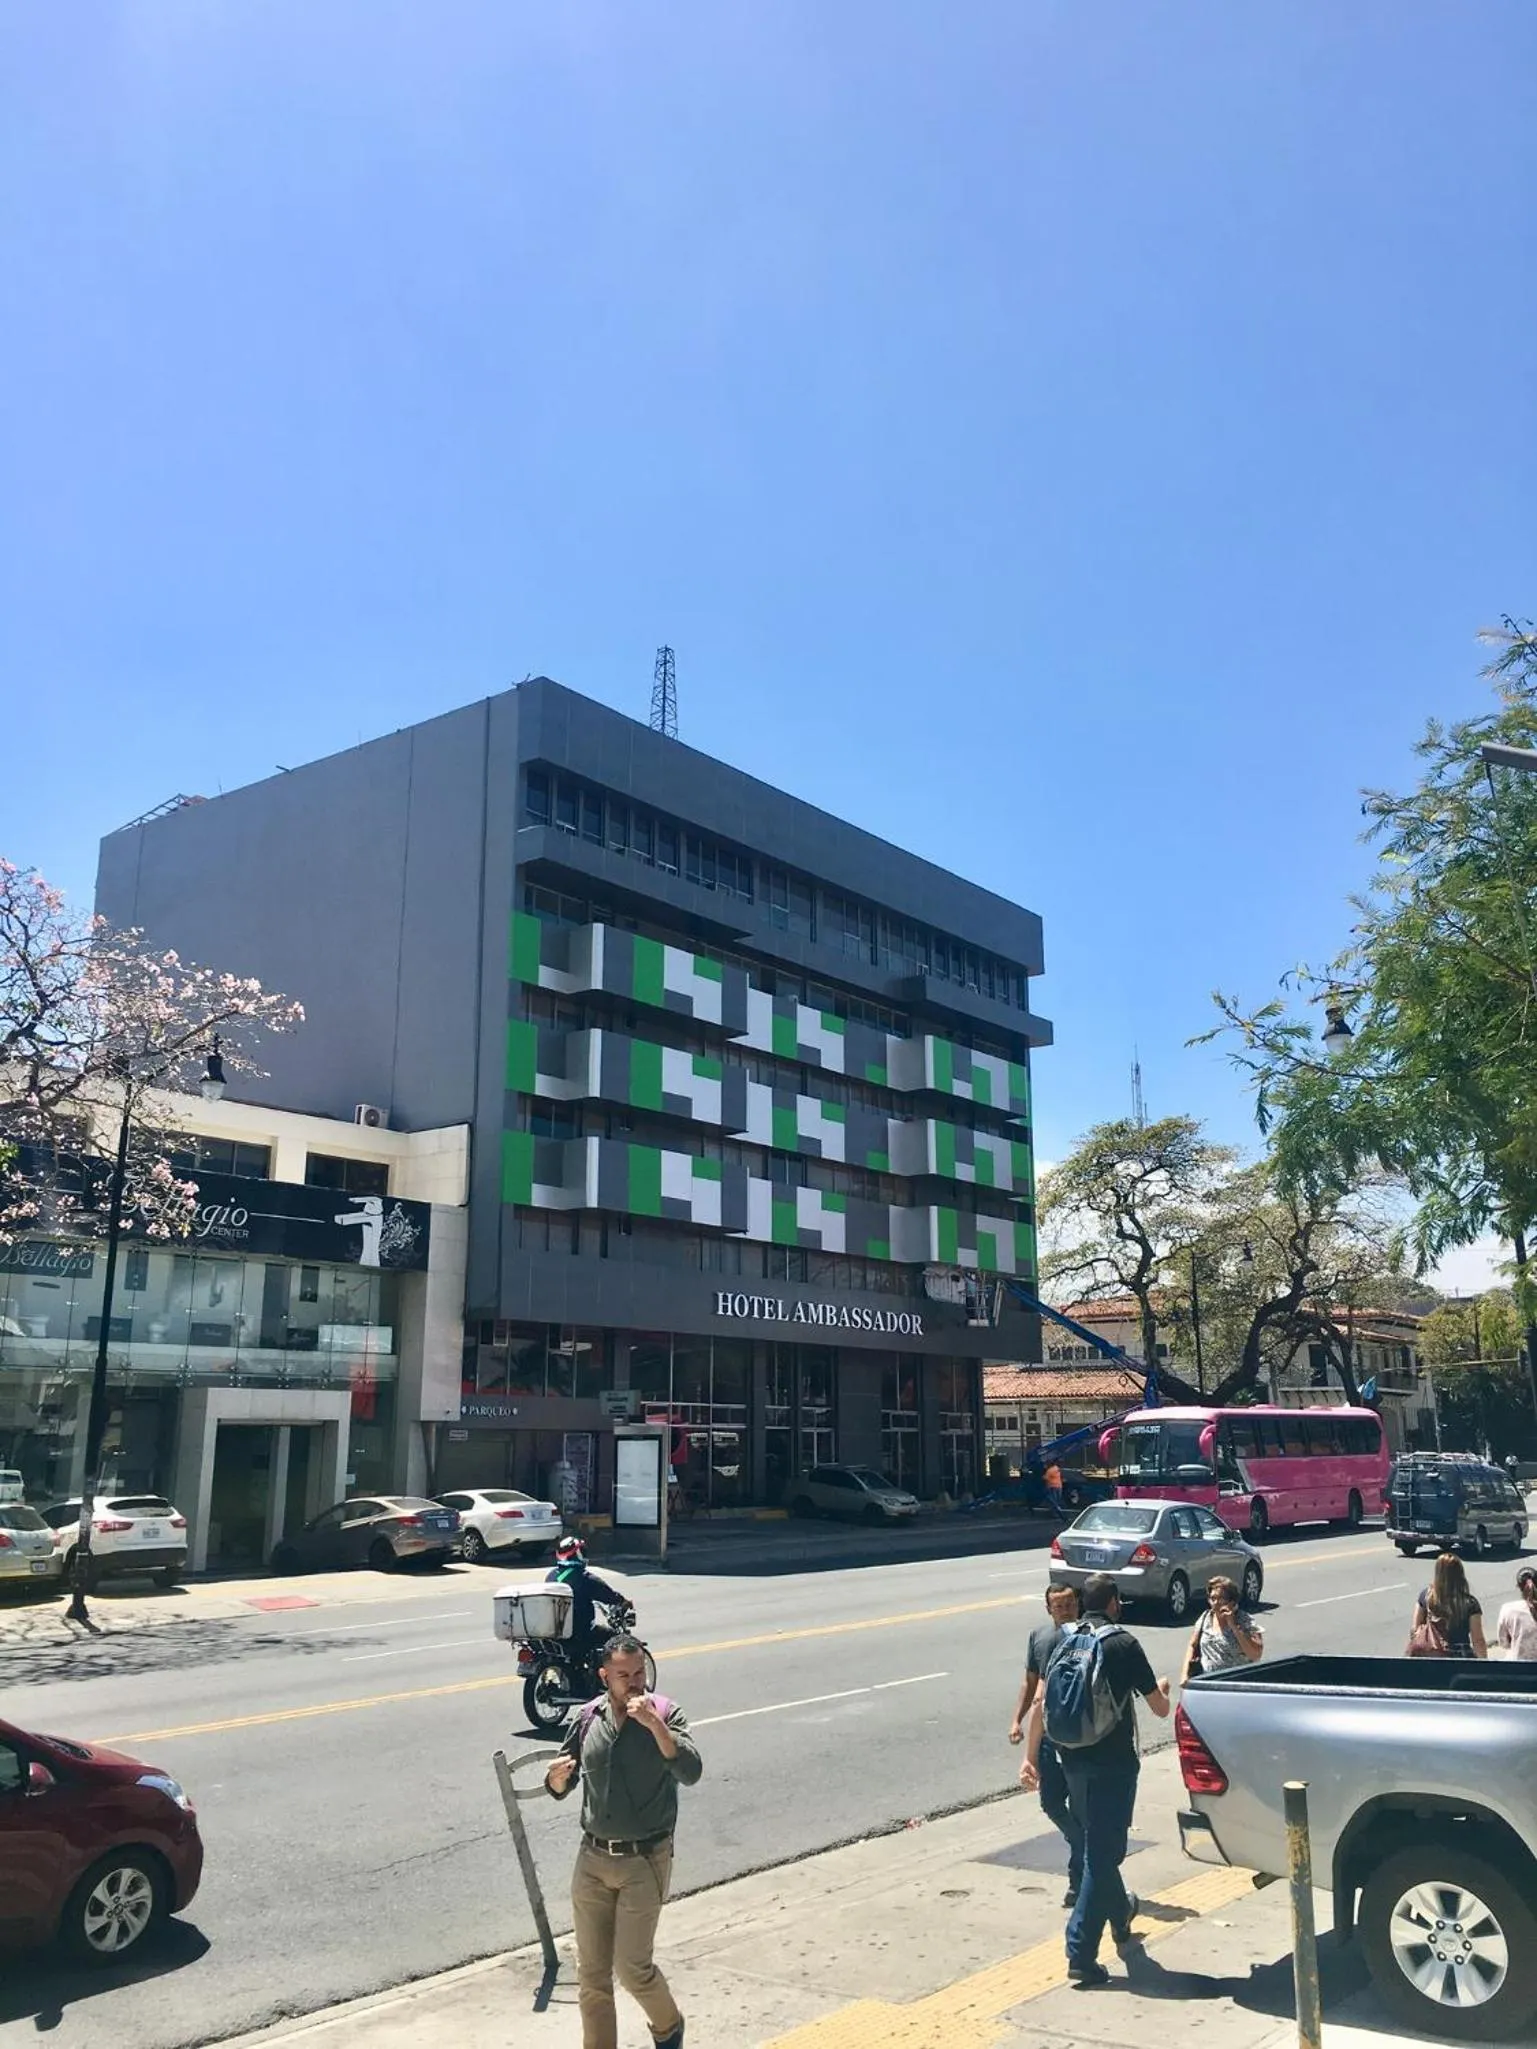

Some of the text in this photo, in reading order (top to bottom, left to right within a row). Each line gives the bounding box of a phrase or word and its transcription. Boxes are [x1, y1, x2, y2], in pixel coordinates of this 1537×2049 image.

[210, 1227, 250, 1239] CENTER
[716, 1291, 923, 1335] HOTEL AMBASSADOR
[469, 1405, 511, 1418] PARQUEO
